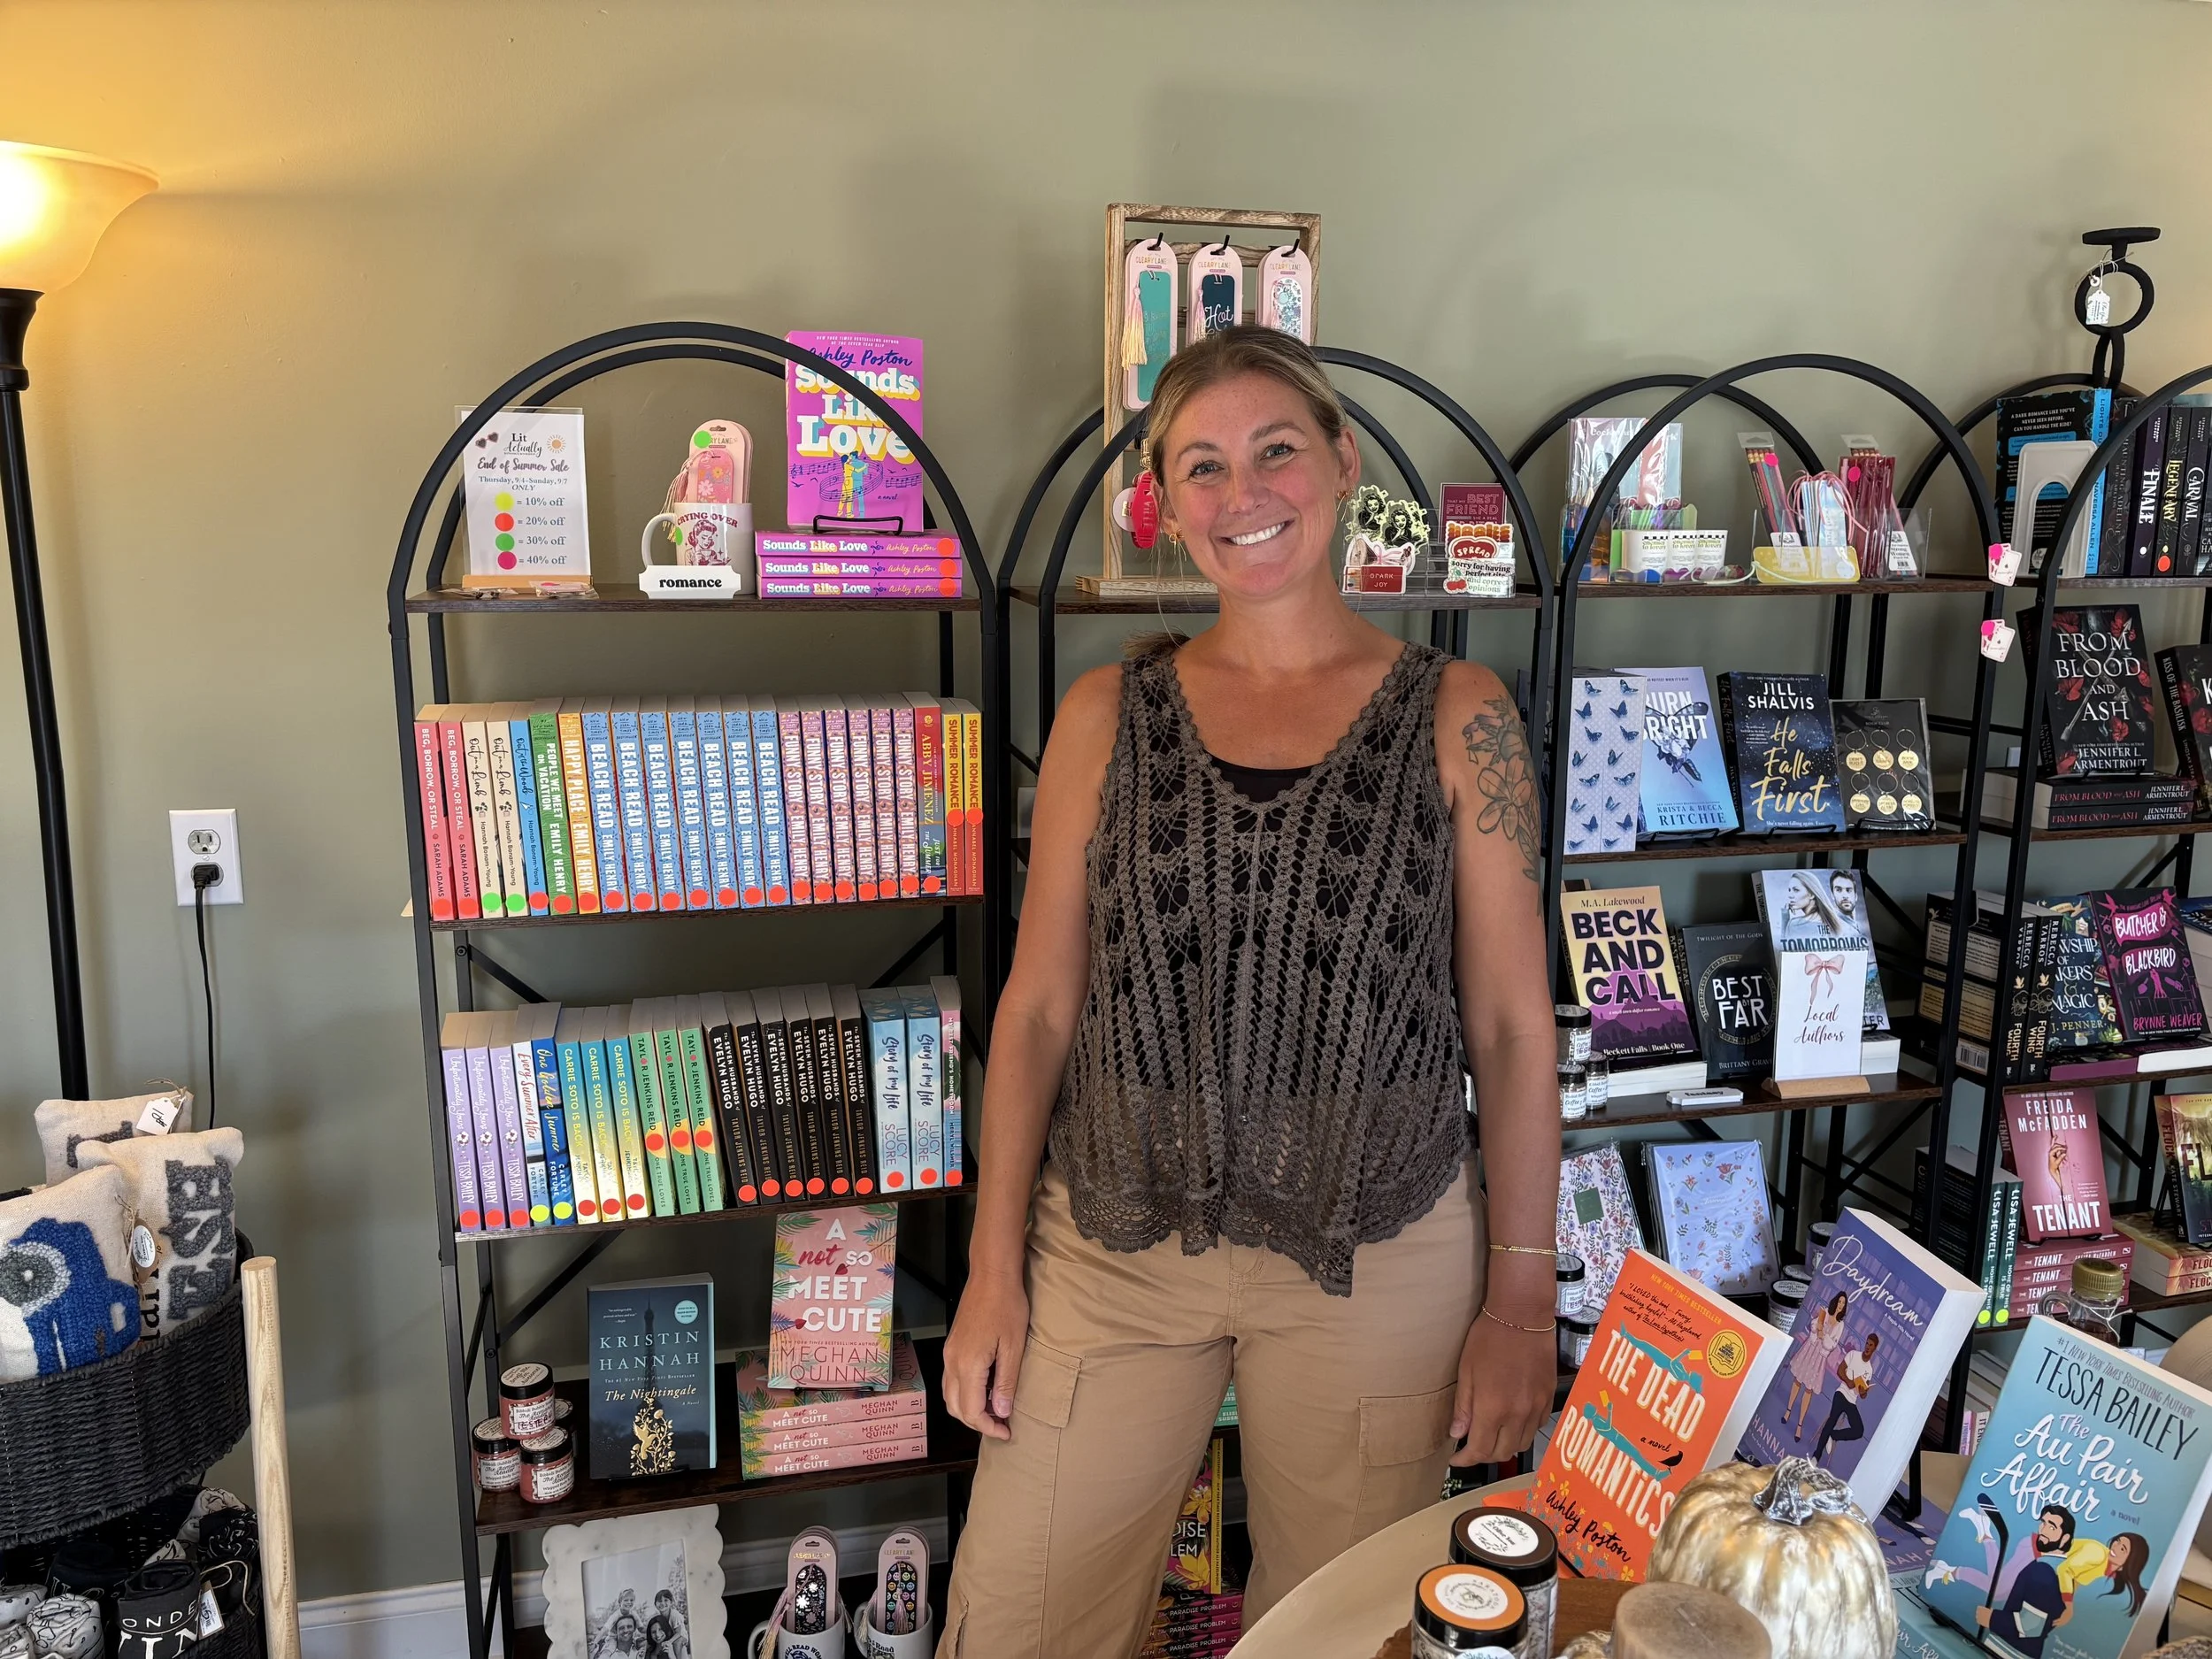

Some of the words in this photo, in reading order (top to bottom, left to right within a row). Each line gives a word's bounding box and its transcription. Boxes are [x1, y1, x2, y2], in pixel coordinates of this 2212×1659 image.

[1205, 303, 1233, 329] Hot
[503, 442, 543, 457] Actually
[511, 434, 526, 442] Lit
[796, 415, 912, 459] Love
[478, 458, 495, 471] End
[500, 461, 511, 473] of
[513, 459, 547, 472] Summer
[550, 460, 569, 472] Sale
[526, 497, 546, 506] 10%
[549, 497, 565, 506] off
[1467, 494, 1499, 503] BEST
[2139, 469, 2160, 524] FINALE
[2163, 460, 2183, 523] LEGENDARY
[2185, 467, 2205, 521] CARAVAL
[526, 517, 547, 526] 20%
[550, 517, 565, 526] off
[677, 511, 707, 531] CRYING
[710, 513, 738, 528] OVER
[1447, 504, 1499, 514] FRIEND
[526, 536, 548, 545] 30%
[551, 536, 566, 545] off
[763, 540, 806, 551] Sounds
[810, 540, 835, 551] Like
[839, 541, 867, 552] Love
[887, 544, 910, 553] Ashley
[911, 545, 936, 554] Poston
[1457, 546, 1490, 557] SPREAD
[527, 556, 549, 565] 40%
[551, 556, 566, 565] off
[1452, 561, 1473, 571] sorry
[1486, 564, 1510, 573] having
[659, 576, 722, 588] romance
[2057, 633, 2131, 652] FROM
[2055, 657, 2140, 679] BLOOD
[1763, 682, 1796, 695] JILL
[2092, 685, 2115, 694] AND
[1748, 694, 1814, 710] SHALVIS
[2082, 702, 2130, 721] ASH
[949, 719, 958, 759] SUMMER
[1772, 718, 1797, 742] He
[564, 740, 581, 776] HAPPY
[784, 734, 800, 769] FUNNY
[922, 734, 933, 767] ABBY
[2079, 748, 2131, 757] JENNIFER
[1764, 748, 1812, 779] Falls
[2073, 759, 2147, 770] ARMENTROUT
[569, 779, 585, 813] PLACE
[787, 772, 805, 803] STORY
[923, 771, 934, 825] JIMENEZ
[950, 763, 959, 808] ROMANCE
[1751, 775, 1832, 820] First
[1659, 813, 1726, 825] RITCHIE
[1580, 899, 1601, 908] M.A.
[1603, 896, 1645, 906] Lakewood
[1571, 909, 1662, 939] BECK
[2114, 913, 2158, 939] BUTCHER
[2159, 908, 2167, 927] &
[2038, 925, 2048, 964] YARROS
[2045, 920, 2059, 966] REBECCA
[1583, 939, 1664, 973] AND
[2125, 949, 2176, 975] BLACKBIRD
[1586, 972, 1675, 1005] CALL
[1712, 975, 1763, 1000] BEST
[1718, 1001, 1768, 1029] FAR
[1803, 1005, 1839, 1023] Local
[2133, 1015, 2167, 1031] BRYNNE
[2170, 1012, 2202, 1026] WEAVER
[1794, 1026, 1844, 1044] Authors
[2026, 1026, 2038, 1053] WING
[2035, 1020, 2047, 1058] FOURTH
[1603, 1048, 1630, 1056] Beckett
[1632, 1045, 1647, 1054] Falls
[713, 1037, 727, 1076] EVELYN
[720, 1079, 733, 1110] HUGO
[2026, 1099, 2073, 1115] FREIDA
[2018, 1115, 2087, 1133] McFADDEN
[885, 1124, 896, 1165] SCORE
[895, 1127, 907, 1159] LUCY
[826, 1217, 847, 1240] A
[2032, 1202, 2101, 1232] TENANT
[799, 1244, 843, 1265] not
[788, 1275, 867, 1300] MEET
[1822, 1234, 1924, 1327] Daydream
[802, 1307, 882, 1333] CUTE
[600, 1331, 699, 1348] KRISTIN
[600, 1353, 699, 1371] HANNAH
[780, 1347, 879, 1363] MEGHAN
[790, 1364, 866, 1385] QUINN
[1599, 1330, 1645, 1395] THE
[1636, 1364, 1706, 1443] DEAD
[2057, 1338, 2069, 1353] #1
[2070, 1344, 2085, 1360] NEW
[2085, 1352, 2104, 1370] YORK
[2103, 1362, 2124, 1380] TIMES
[2123, 1372, 2162, 1402] BESTSELLING
[2162, 1394, 2195, 1418] AUTHOR
[605, 1390, 626, 1401] The
[630, 1385, 696, 1400] Nightingale
[2036, 1347, 2104, 1416] TESSA
[2105, 1386, 2199, 1460] BAILEY
[2059, 1413, 2089, 1440] The
[2015, 1413, 2074, 1465] Au
[2078, 1437, 2148, 1504] Pair
[1555, 1405, 1676, 1539] ROMANTICS
[1981, 1454, 2101, 1521] Affair
[1547, 1490, 1580, 1533] Ashley
[1582, 1522, 1632, 1563] Poston
[2118, 1511, 2140, 1525] novel
